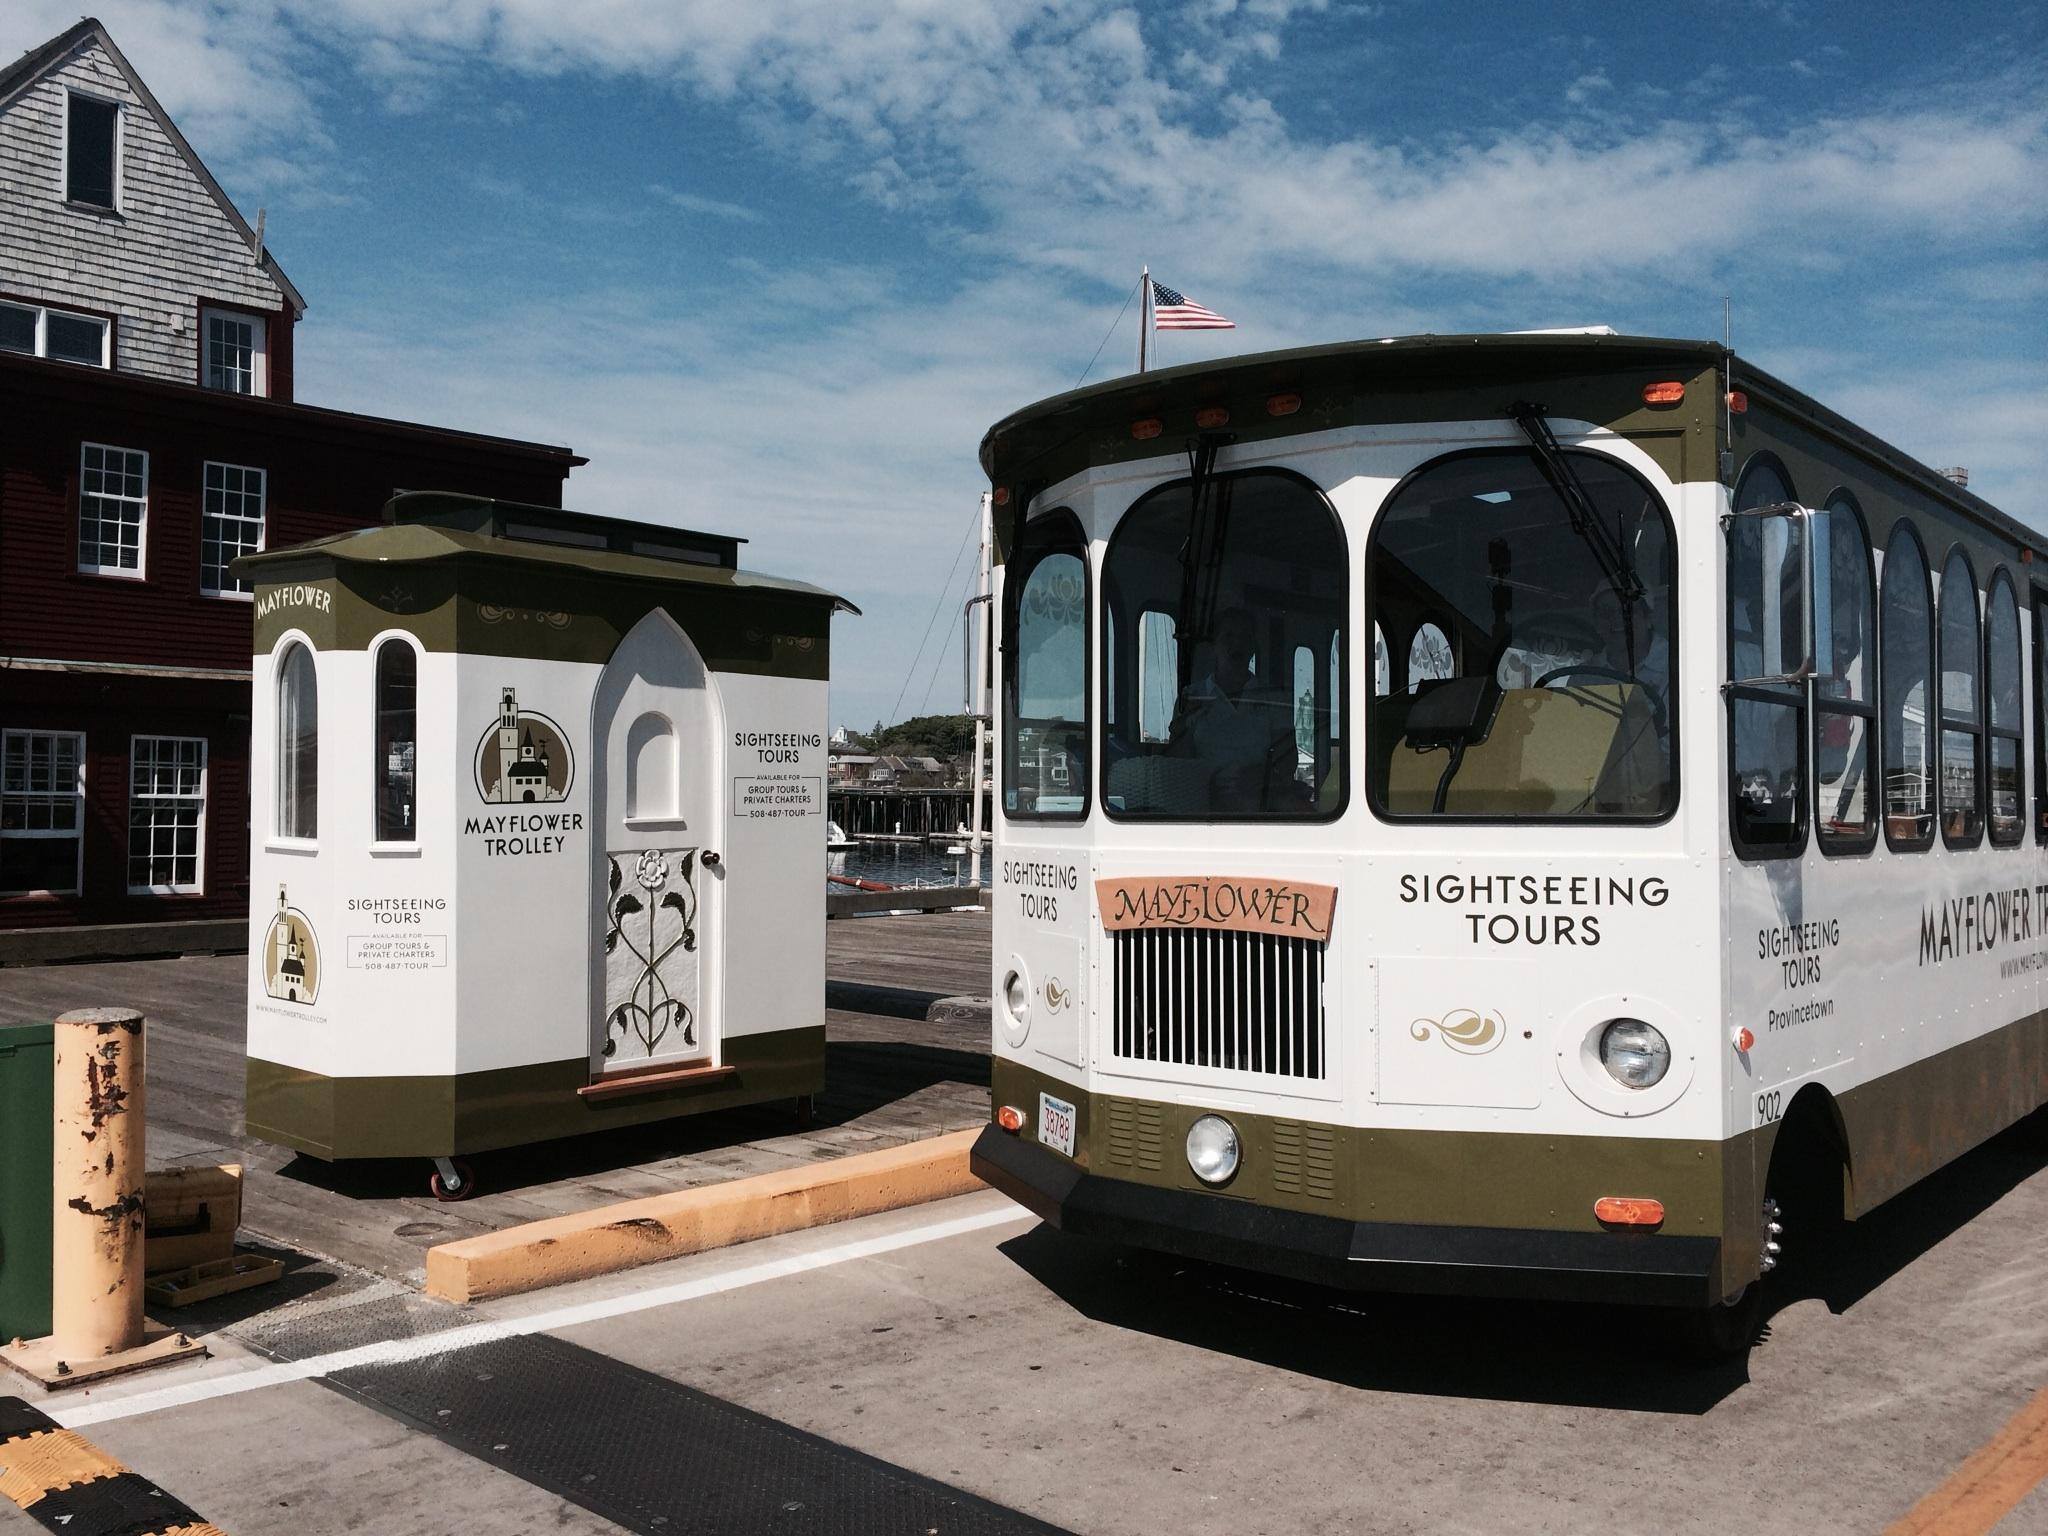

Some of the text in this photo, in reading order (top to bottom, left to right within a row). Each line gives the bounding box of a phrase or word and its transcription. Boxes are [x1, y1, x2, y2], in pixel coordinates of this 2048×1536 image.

[257, 585, 331, 620] MAYFLOWER
[735, 732, 821, 748] SIGHTSEEING
[757, 749, 800, 763] TOURS
[743, 795, 812, 804] PRIVATE CHARTERS
[748, 785, 808, 794] GROUP TOURS &
[464, 813, 584, 835] MAYFLOWER
[484, 836, 566, 857] TROLLEY
[1003, 860, 1077, 891] SIGHTSEEING
[1399, 873, 1670, 907] SIGHTSEEING
[347, 898, 447, 911] SIGHTSEEING
[373, 912, 422, 924] TOURS
[1020, 893, 1058, 922] TOURS
[1114, 878, 1326, 933] MAYFLOWER
[1465, 913, 1601, 947] TOURS
[1758, 918, 1840, 960] SIGHTSEEING
[1918, 887, 2031, 967] MAYFLOWER
[362, 942, 393, 950] GROUP
[394, 942, 422, 950] TOURS
[393, 950, 435, 958] CHARTERS
[1782, 955, 1821, 990] TOURS
[1768, 999, 1834, 1032] Provincetown
[1757, 1090, 1782, 1126] 902
[1044, 1107, 1070, 1143] 38788
